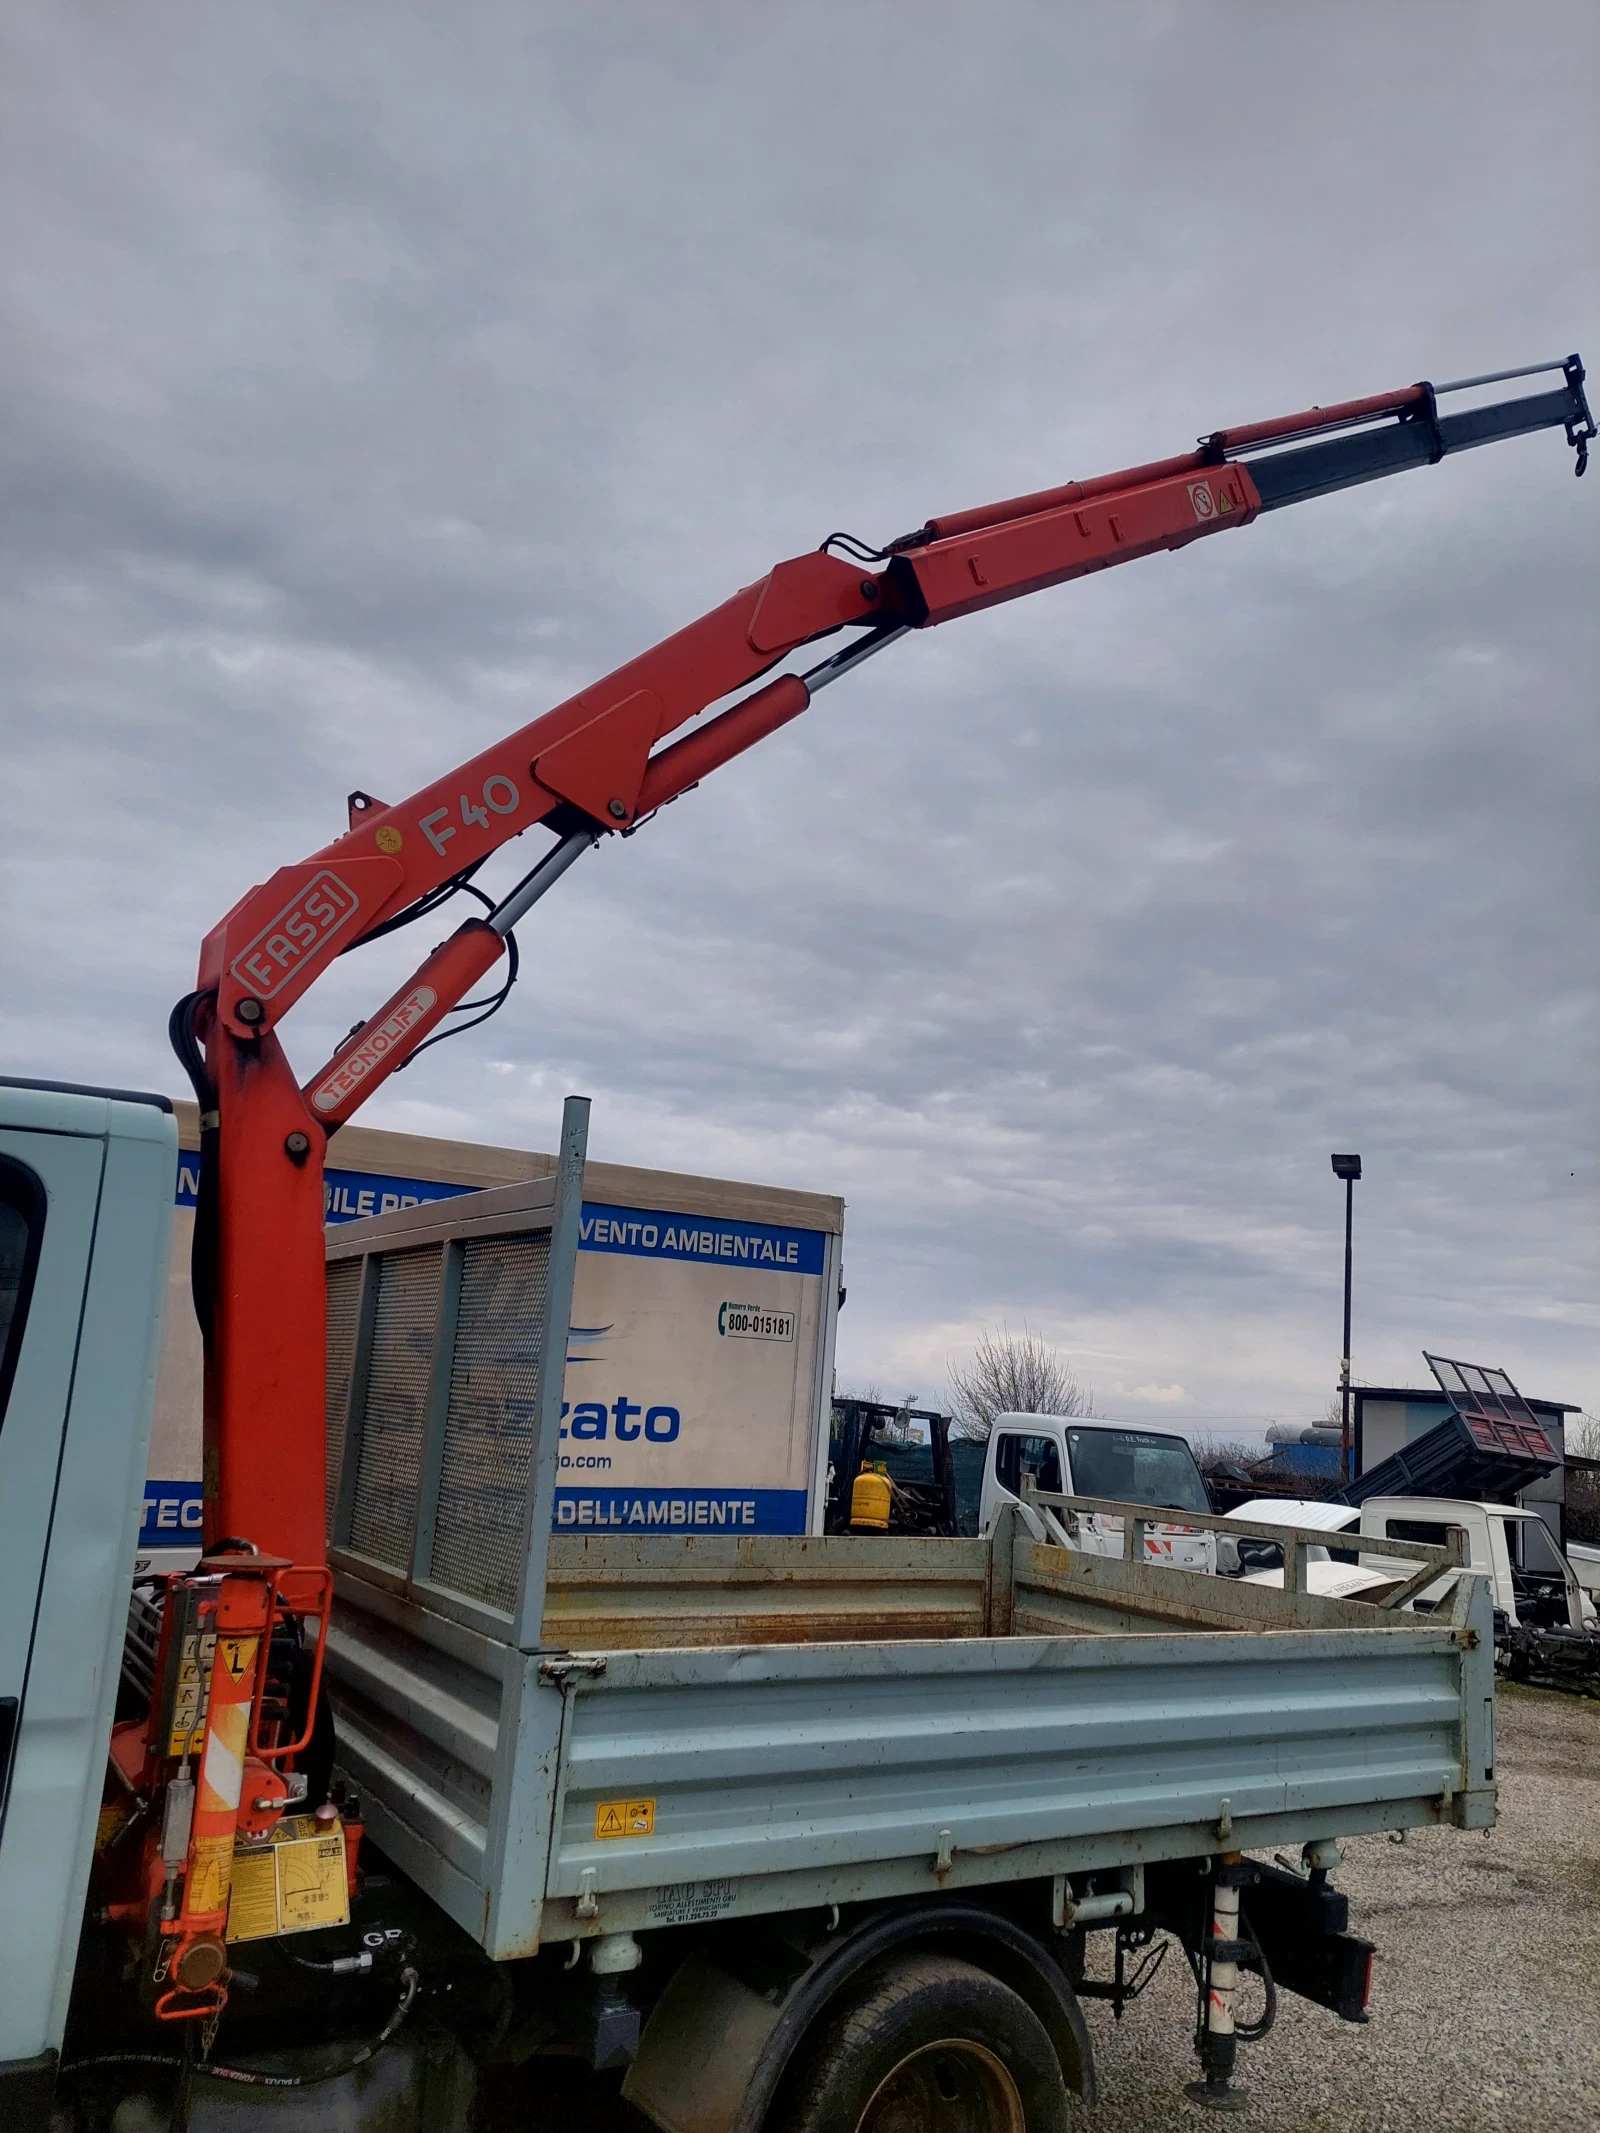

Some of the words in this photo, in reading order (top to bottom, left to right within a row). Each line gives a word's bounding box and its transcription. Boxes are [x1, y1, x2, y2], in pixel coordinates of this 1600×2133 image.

[245, 883, 346, 987] FASSI
[321, 995, 429, 1100] TECNOLIFT
[662, 1227, 800, 1264] AMBIENTALE
[728, 1302, 746, 1311] Numero
[747, 1304, 760, 1312] Verde
[728, 1313, 790, 1336] 800-015181
[557, 1499, 757, 1526] DELL'AMBIENTE
[1333, 1580, 1365, 1594] NISSAN
[297, 1820, 308, 1839] STOP
[648, 1902, 675, 1912] TORINO
[676, 1896, 721, 1908] ALLESTIMENTI
[722, 1894, 737, 1903] GRU
[230, 2072, 256, 2083] FORZA
[265, 2078, 293, 2086] BALFLEX
